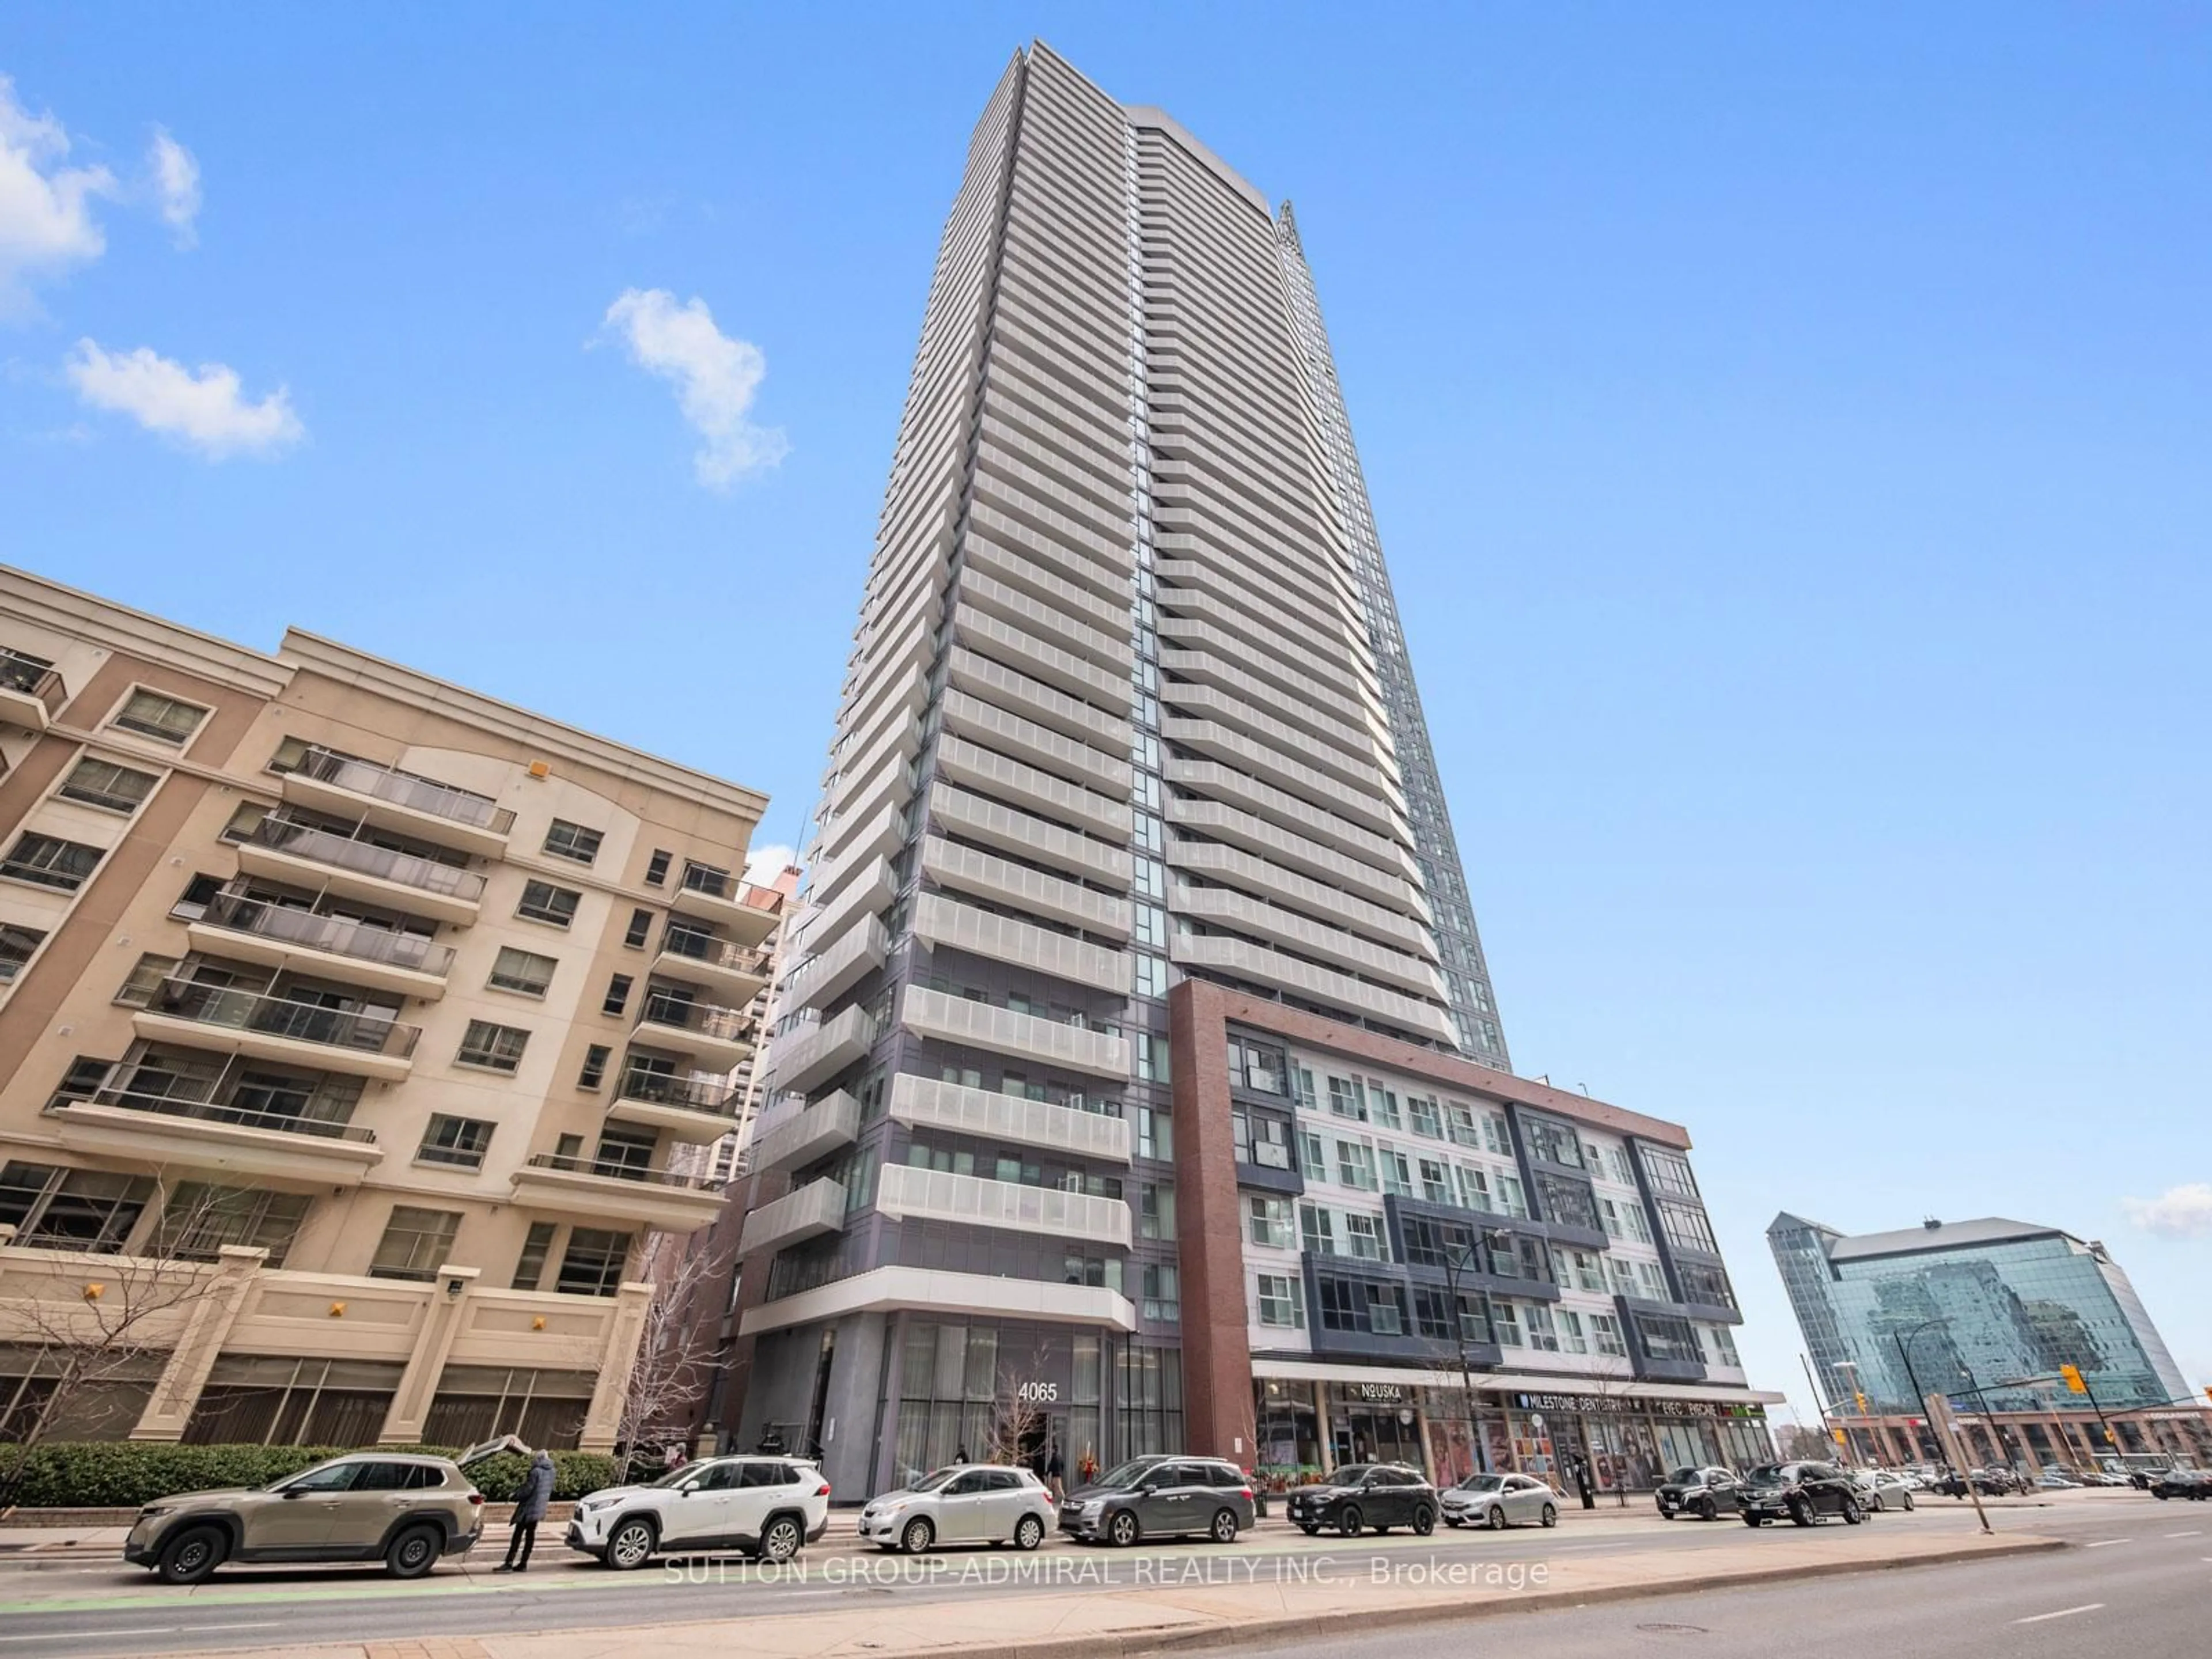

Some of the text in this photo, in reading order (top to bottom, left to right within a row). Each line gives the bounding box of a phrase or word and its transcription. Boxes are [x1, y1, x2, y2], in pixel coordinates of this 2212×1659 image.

[1018, 1382, 1057, 1402] 4065
[1361, 1383, 1402, 1399] NOUSKA
[1529, 1393, 1578, 1410] MILESTONE
